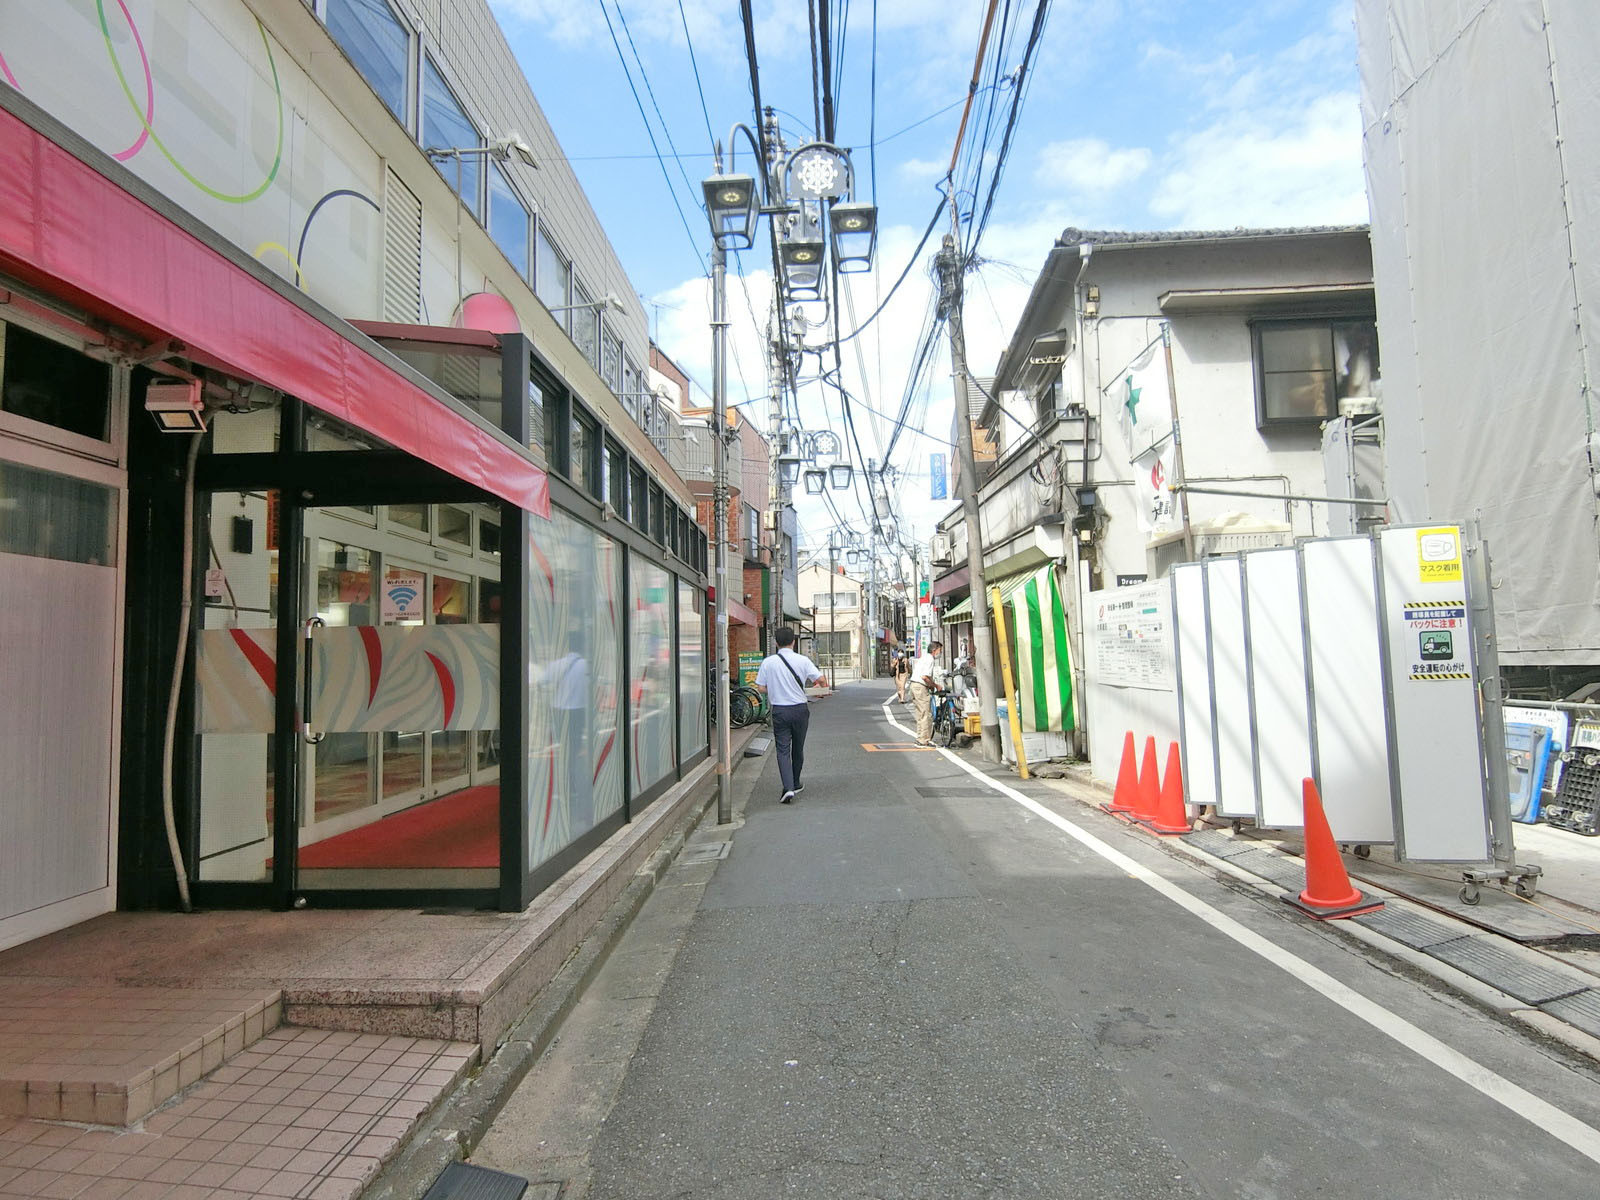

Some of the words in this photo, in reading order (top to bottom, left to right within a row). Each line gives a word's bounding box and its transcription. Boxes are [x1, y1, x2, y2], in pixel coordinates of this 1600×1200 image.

[1420, 564, 1459, 572] マスク着用
[1412, 662, 1465, 674] 安全運転の心がけ
